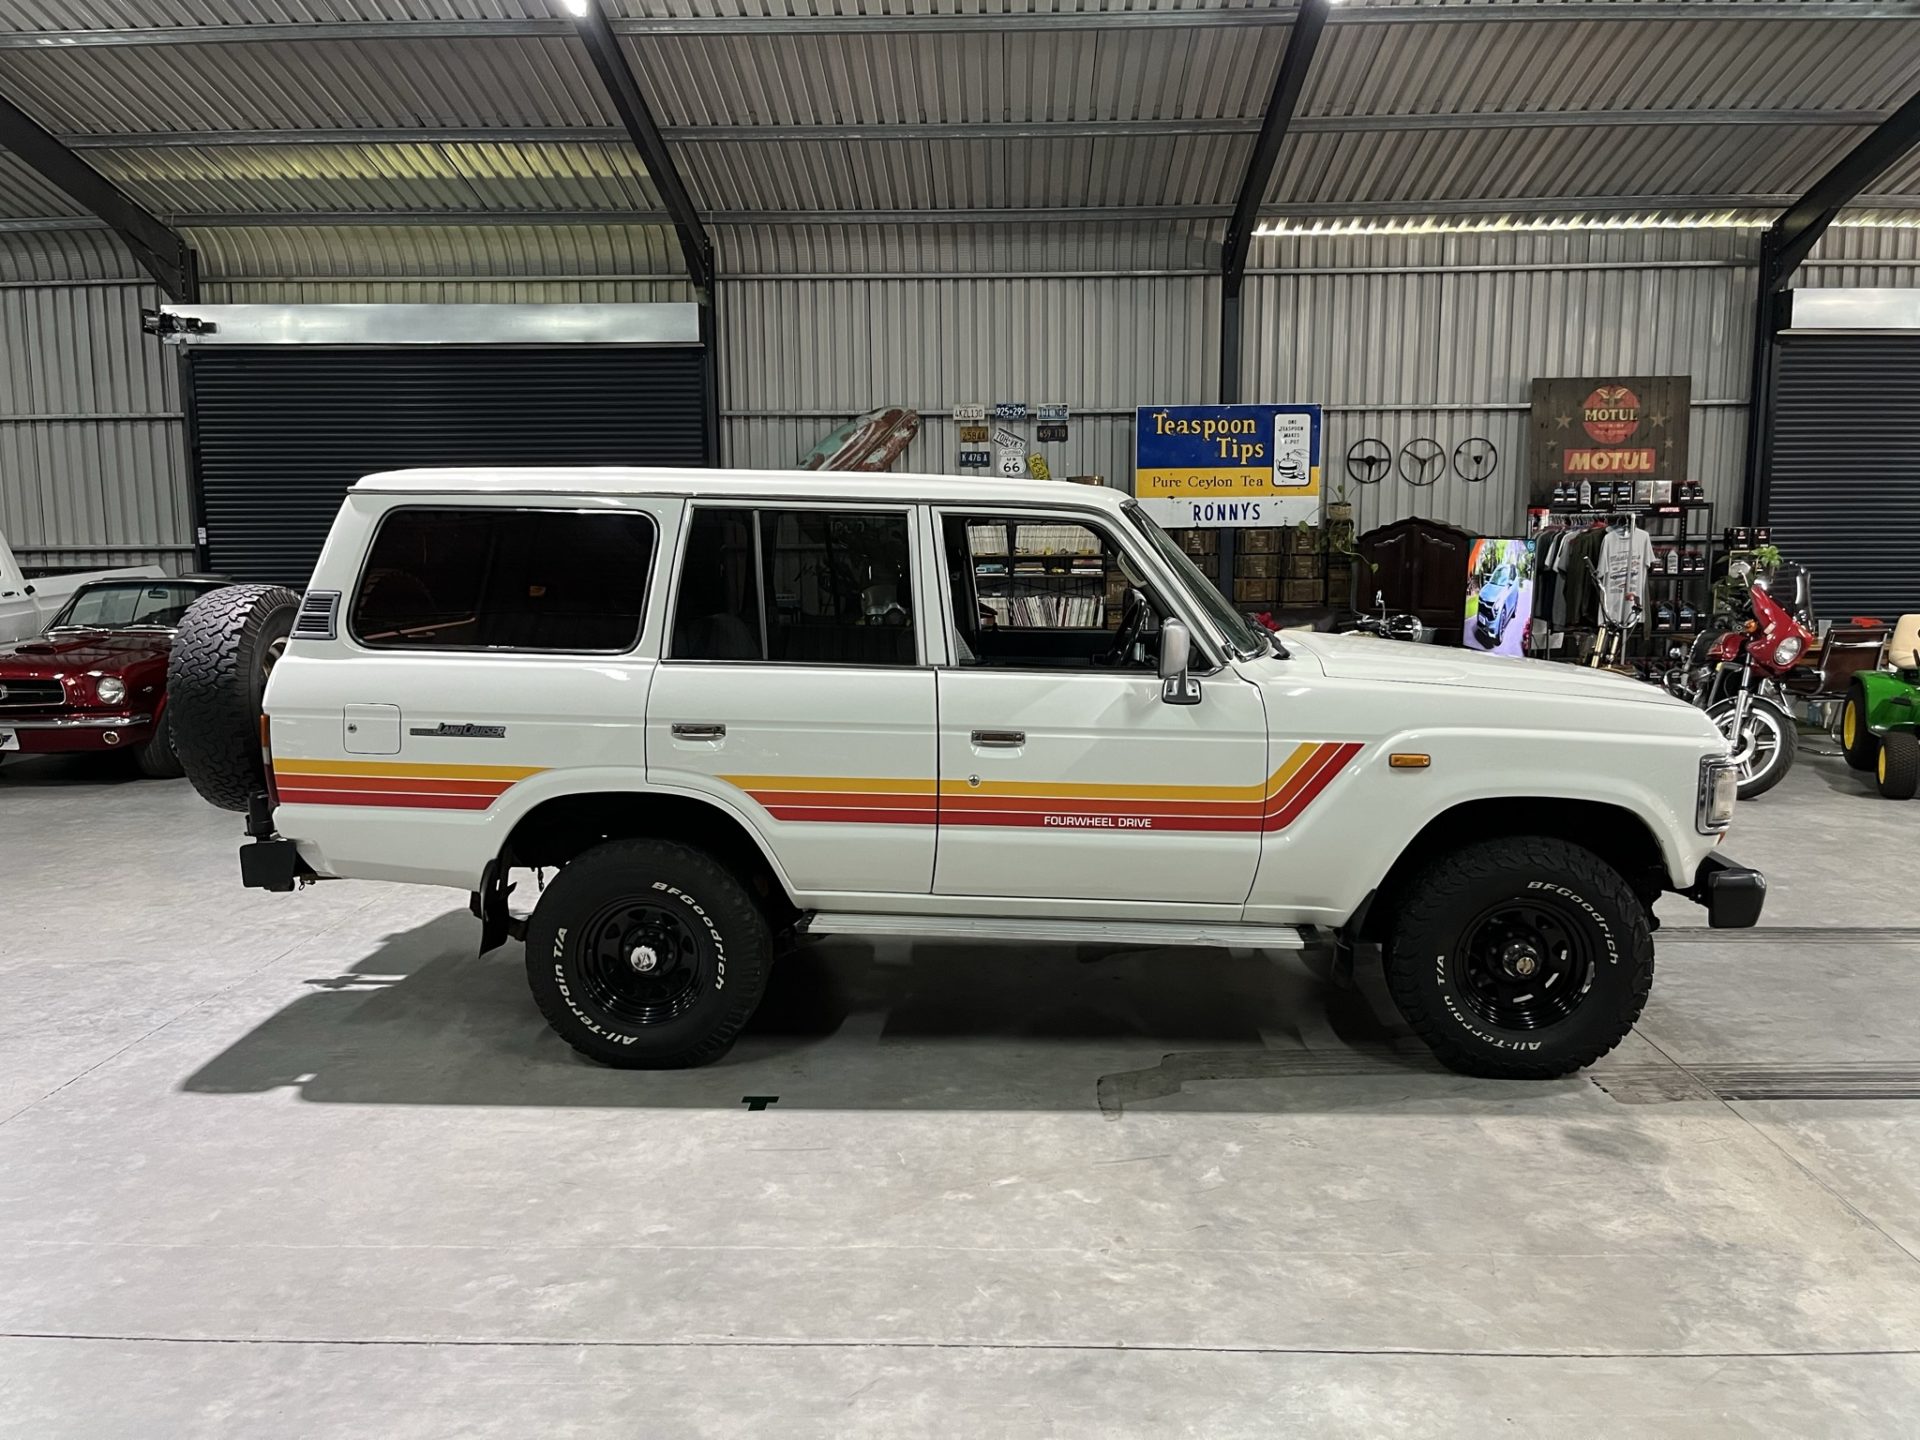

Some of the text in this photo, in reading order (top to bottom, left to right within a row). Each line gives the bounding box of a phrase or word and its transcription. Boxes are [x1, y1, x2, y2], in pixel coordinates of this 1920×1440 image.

[1584, 408, 1638, 421] MOTUL
[1152, 412, 1256, 442] Teaspoon
[1216, 436, 1264, 465] Tips
[1568, 451, 1651, 470] MOTUL
[1004, 462, 1020, 472] 66
[1152, 475, 1264, 490] Pure Ceylon Tea
[1193, 504, 1260, 521] RONNYS
[1043, 815, 1152, 828] FOURWHEEL DRIVE
[1526, 880, 1619, 965] BFGoodrich
[651, 881, 728, 991] BFGoodrich
[553, 927, 639, 1046] All-Terrain T/A
[1436, 955, 1542, 1051] All-Terrain T/A
